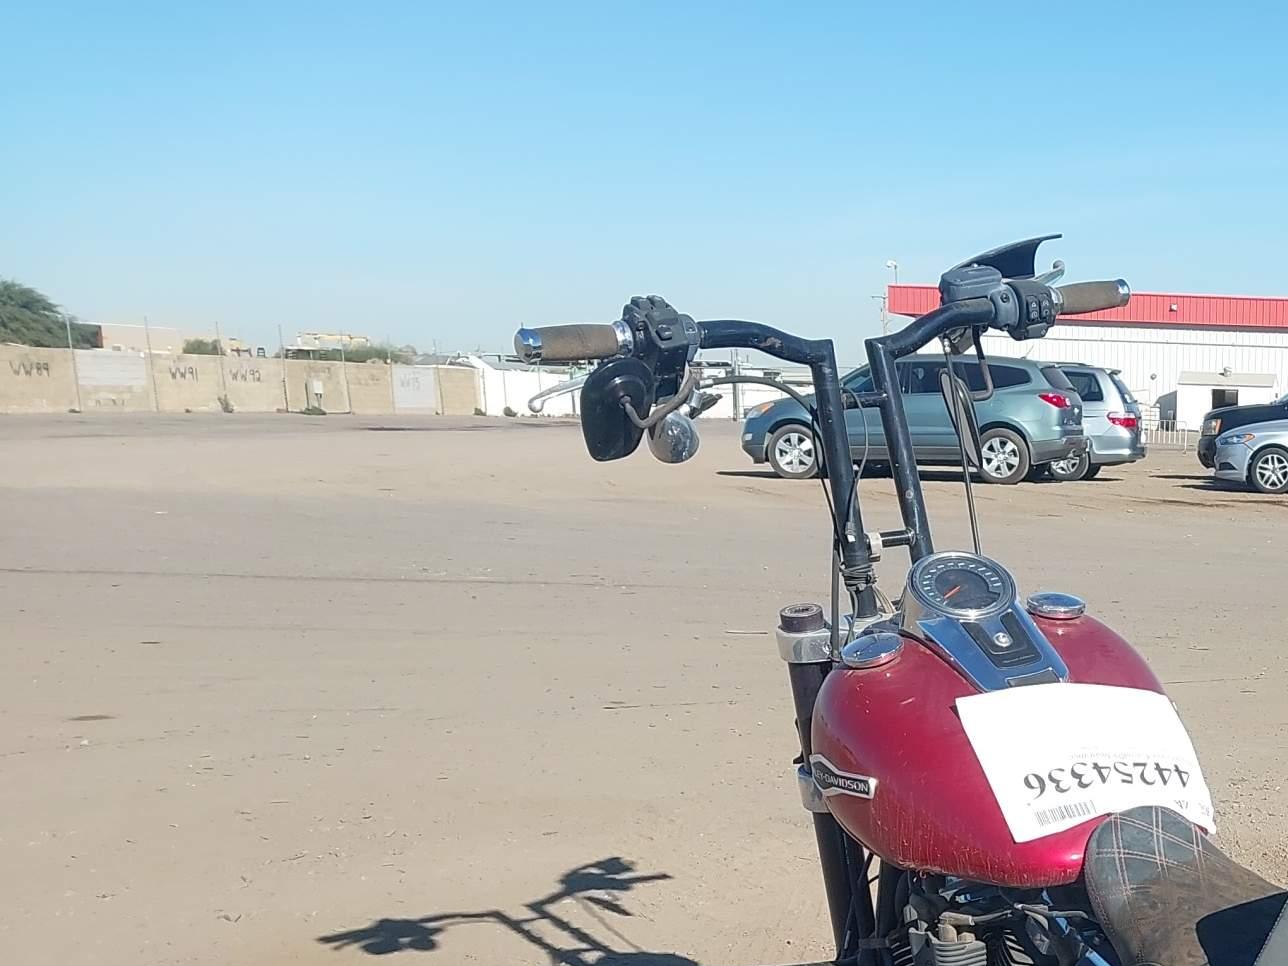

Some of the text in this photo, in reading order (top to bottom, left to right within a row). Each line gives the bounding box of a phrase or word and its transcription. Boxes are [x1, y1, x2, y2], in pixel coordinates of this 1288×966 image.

[9, 360, 50, 377] WW89
[169, 365, 199, 382] WW91
[228, 367, 263, 383] WW92
[1023, 761, 1190, 799] 44254336
